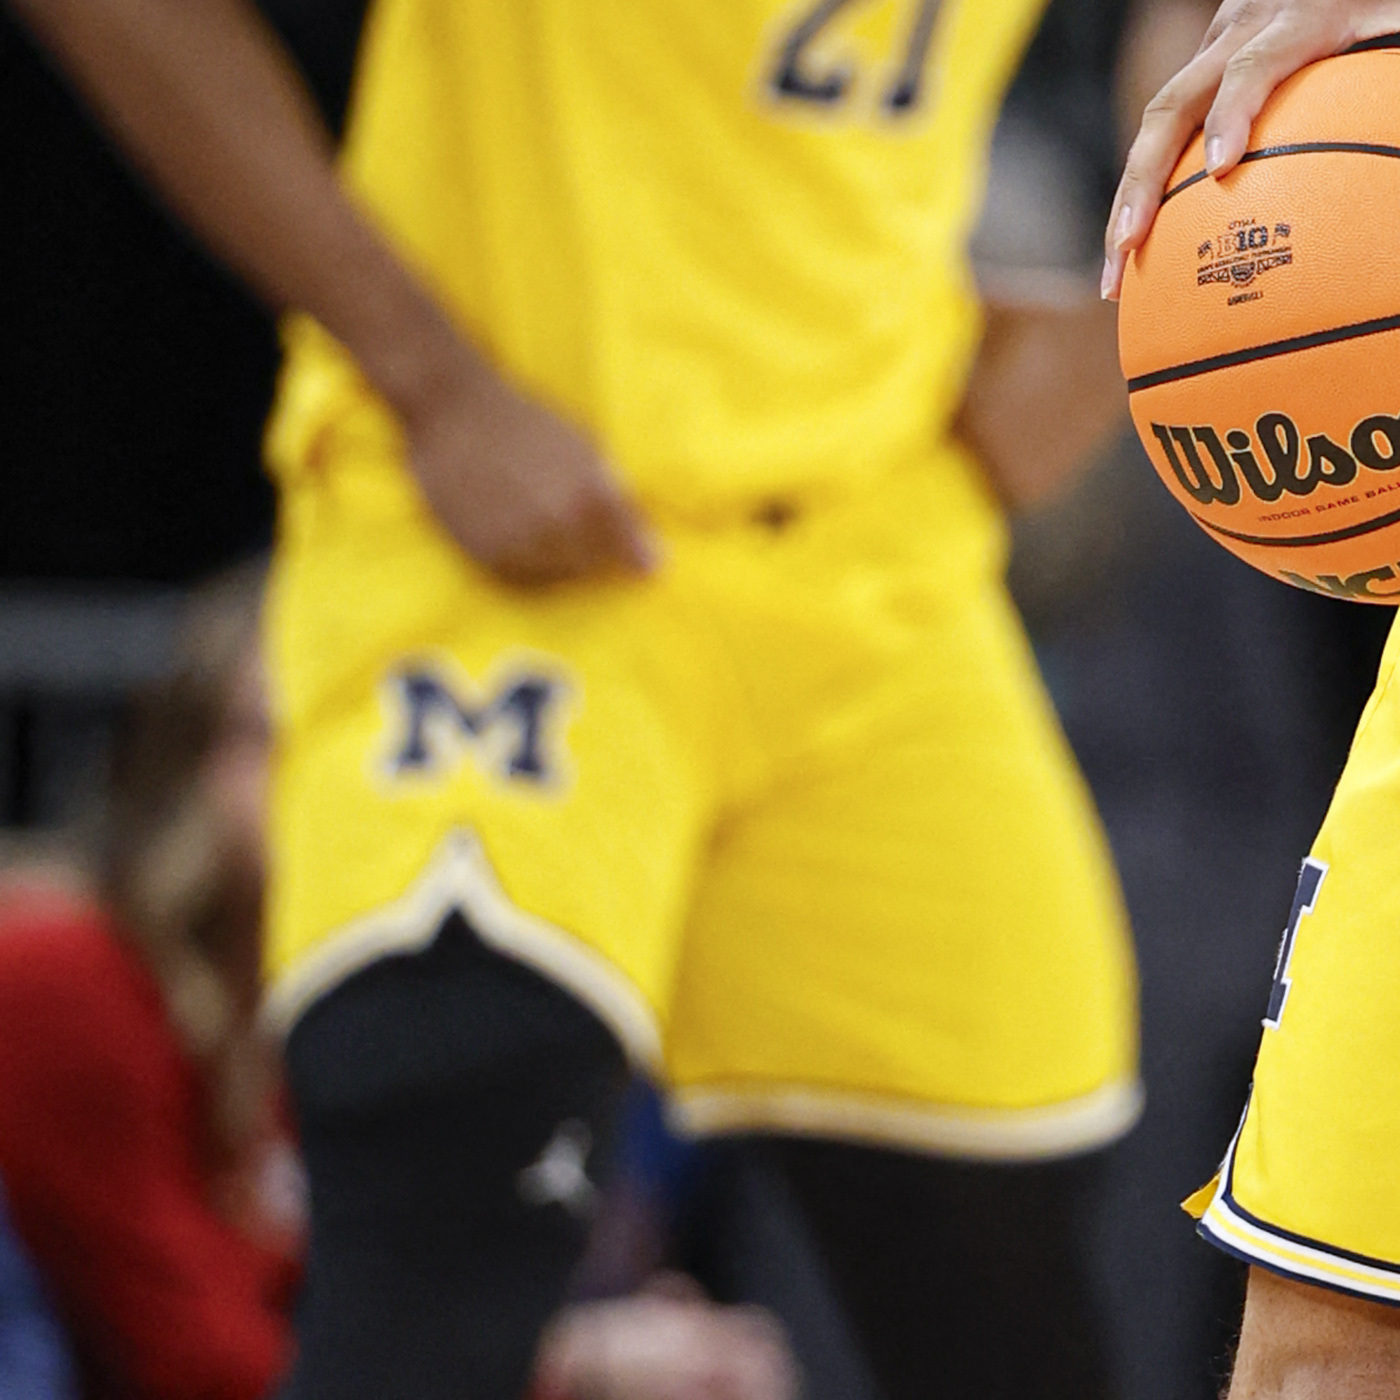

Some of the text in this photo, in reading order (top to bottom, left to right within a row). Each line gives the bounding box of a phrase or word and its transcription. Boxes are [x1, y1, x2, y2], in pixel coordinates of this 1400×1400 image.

[1257, 507, 1311, 522] INDOOR
[1315, 495, 1360, 513] GAME
[383, 658, 572, 793] M
